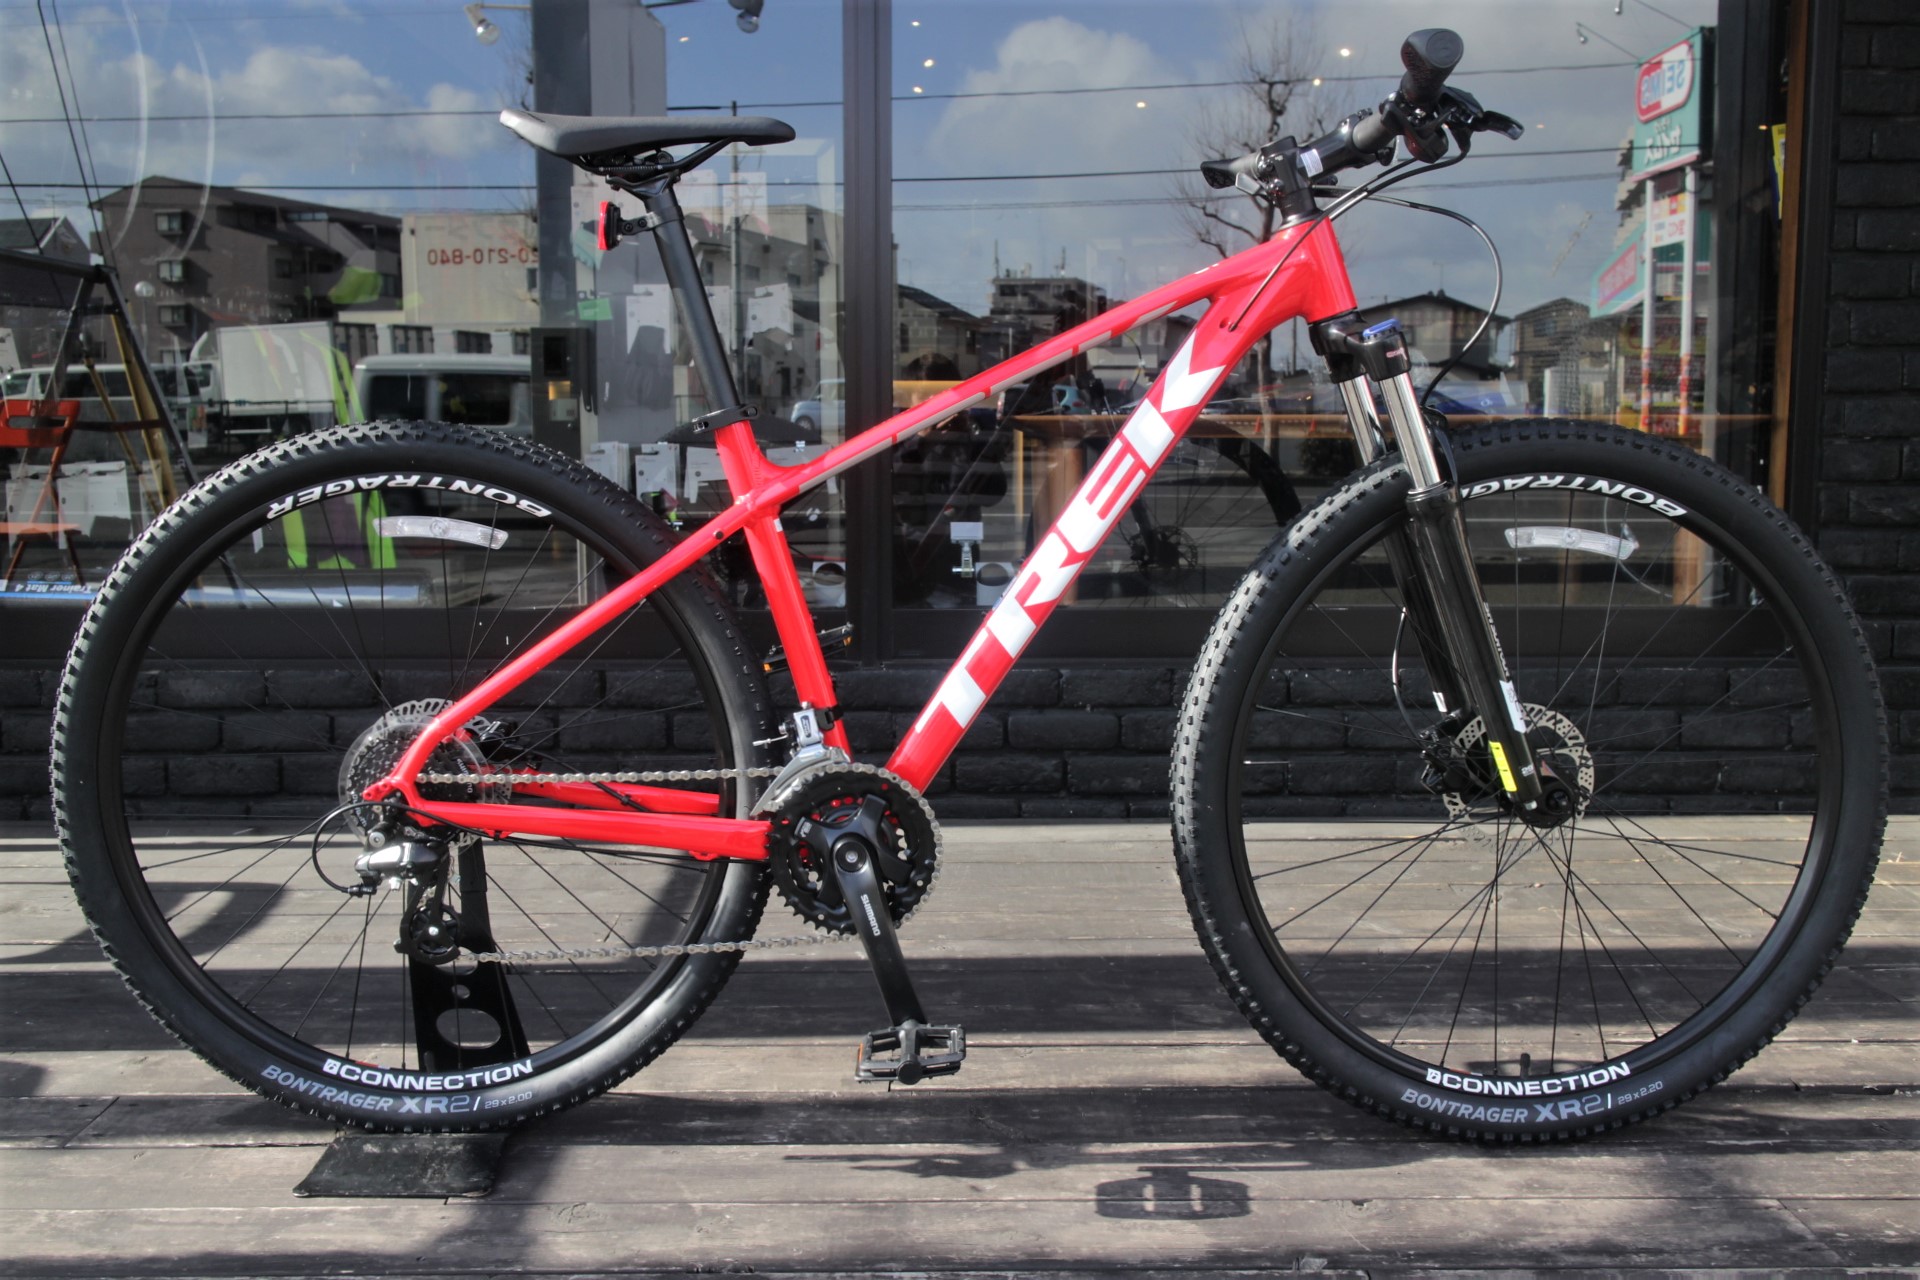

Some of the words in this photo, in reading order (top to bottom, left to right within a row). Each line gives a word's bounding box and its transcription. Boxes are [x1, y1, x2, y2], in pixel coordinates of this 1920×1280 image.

[266, 474, 552, 519] BONTRAGER
[1461, 475, 1687, 517] BONTRAG
[915, 329, 1227, 734] TREK
[861, 893, 881, 937] SHIMANO
[261, 1064, 394, 1112] BONTRAGER
[339, 1059, 534, 1091] CONNECTION
[1442, 1061, 1632, 1096] CONNECTION
[1400, 1088, 1529, 1124] BONTRAGER
